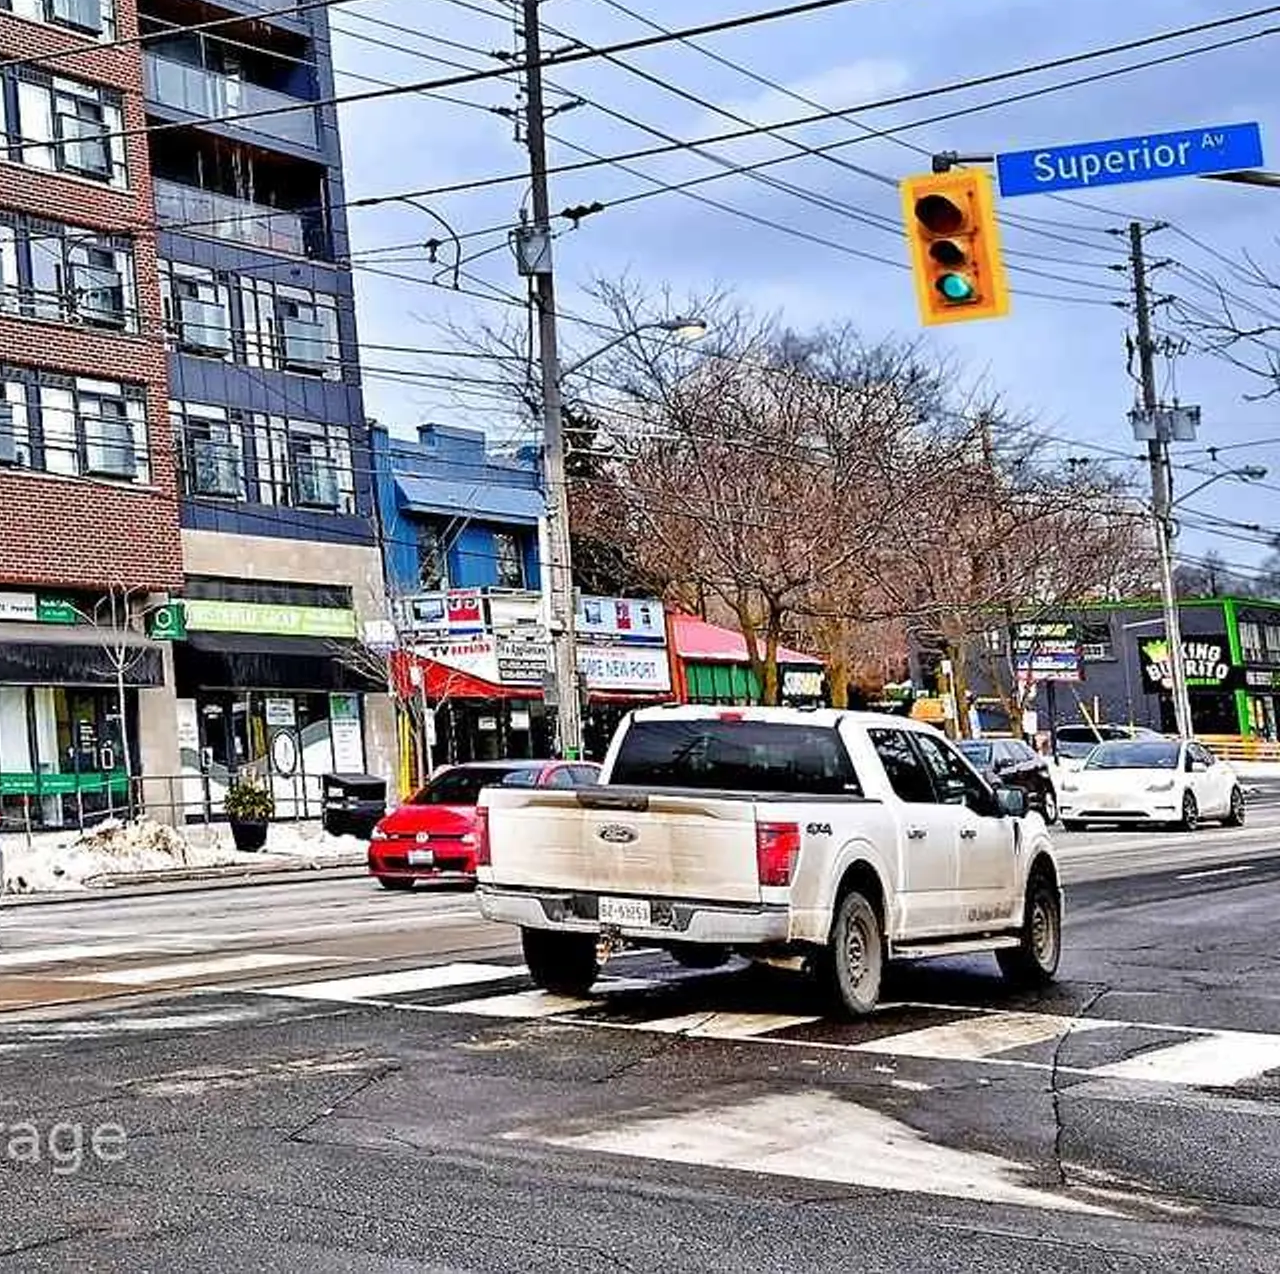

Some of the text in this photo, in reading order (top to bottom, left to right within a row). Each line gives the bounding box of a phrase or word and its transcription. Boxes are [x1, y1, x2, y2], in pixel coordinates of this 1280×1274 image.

[1033, 132, 1224, 184] Superior Av
[429, 646, 450, 657] TV
